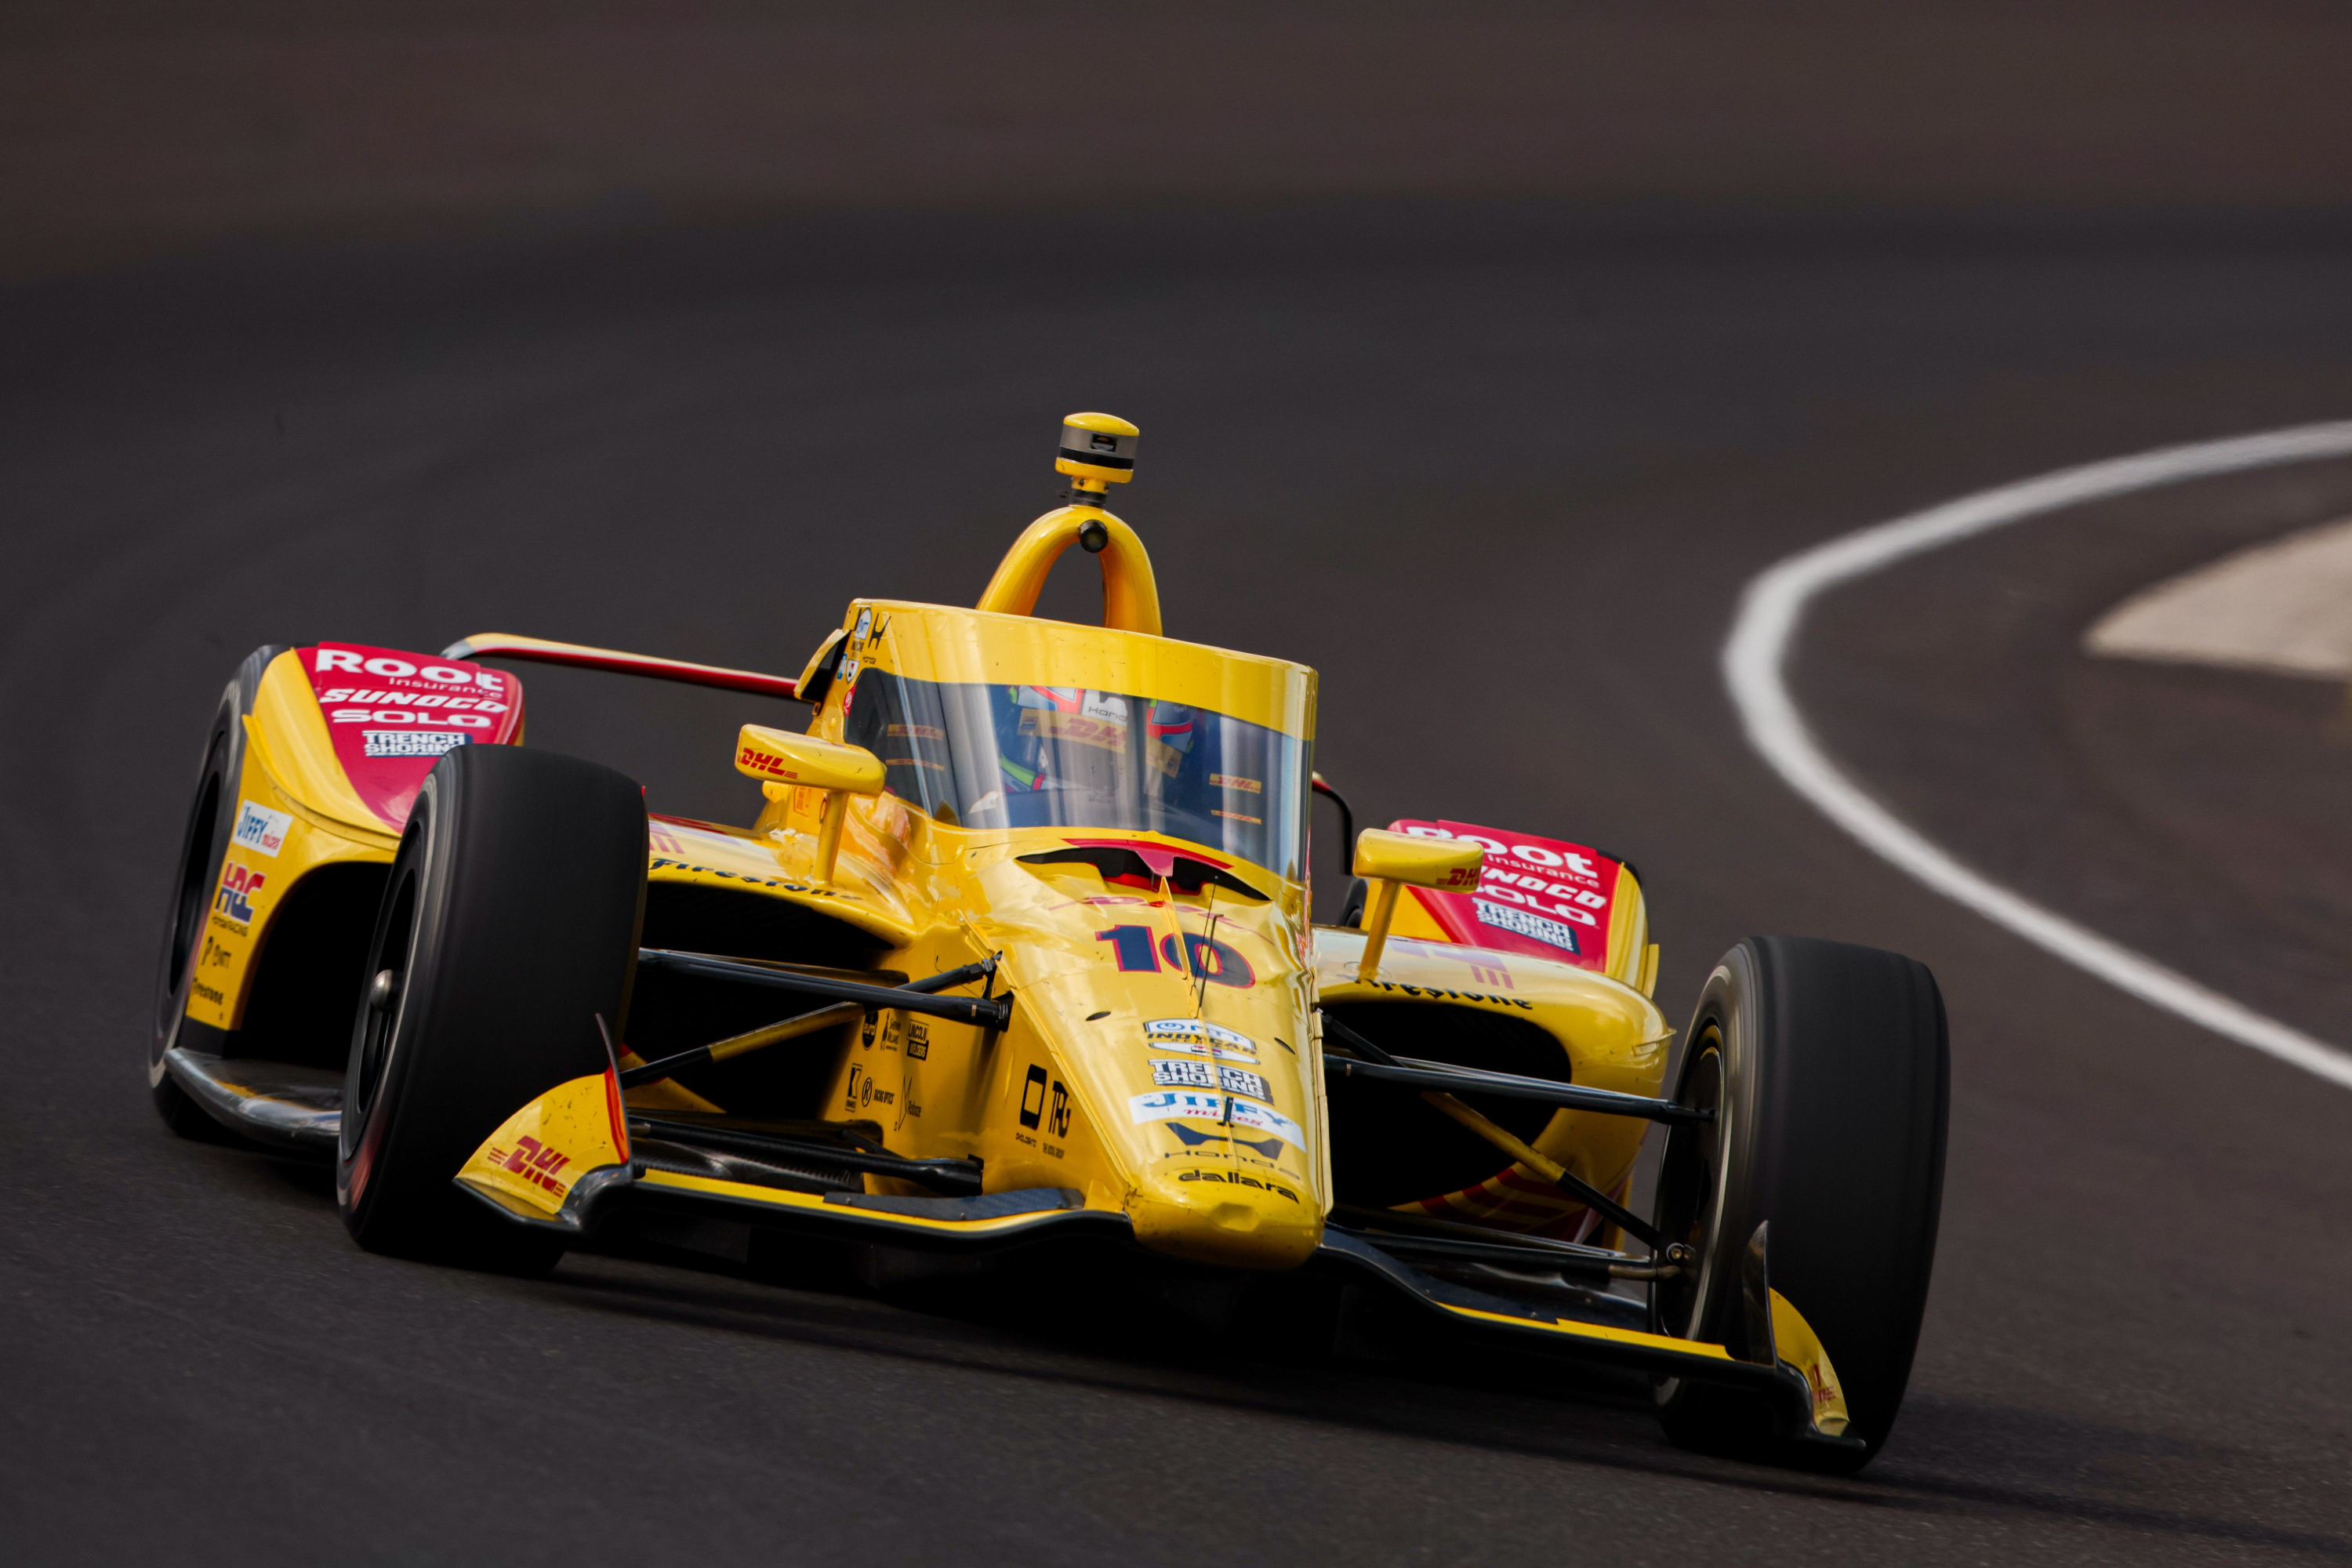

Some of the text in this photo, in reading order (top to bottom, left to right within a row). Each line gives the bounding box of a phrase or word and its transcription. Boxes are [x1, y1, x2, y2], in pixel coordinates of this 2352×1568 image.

[316, 649, 504, 692] Root
[319, 688, 509, 713] SUNOCO
[331, 709, 492, 728] SOLO
[364, 732, 466, 746] TRENCH
[742, 747, 786, 776] DHL
[649, 858, 864, 900] Firestone
[1474, 901, 1570, 938] TRENCH
[1475, 884, 1596, 926] OLO
[1475, 910, 1574, 952] SHORING
[1094, 924, 1256, 989] 10
[909, 1022, 927, 1041] LINCOLN
[909, 1042, 927, 1058] WELDERS
[1152, 1061, 1263, 1087] TRENCH
[1152, 1072, 1265, 1099] SHORING
[1184, 1109, 1263, 1127] mies
[502, 1134, 571, 1192] DHL
[1164, 1150, 1301, 1181] Honda
[1178, 1169, 1300, 1204] dallara
